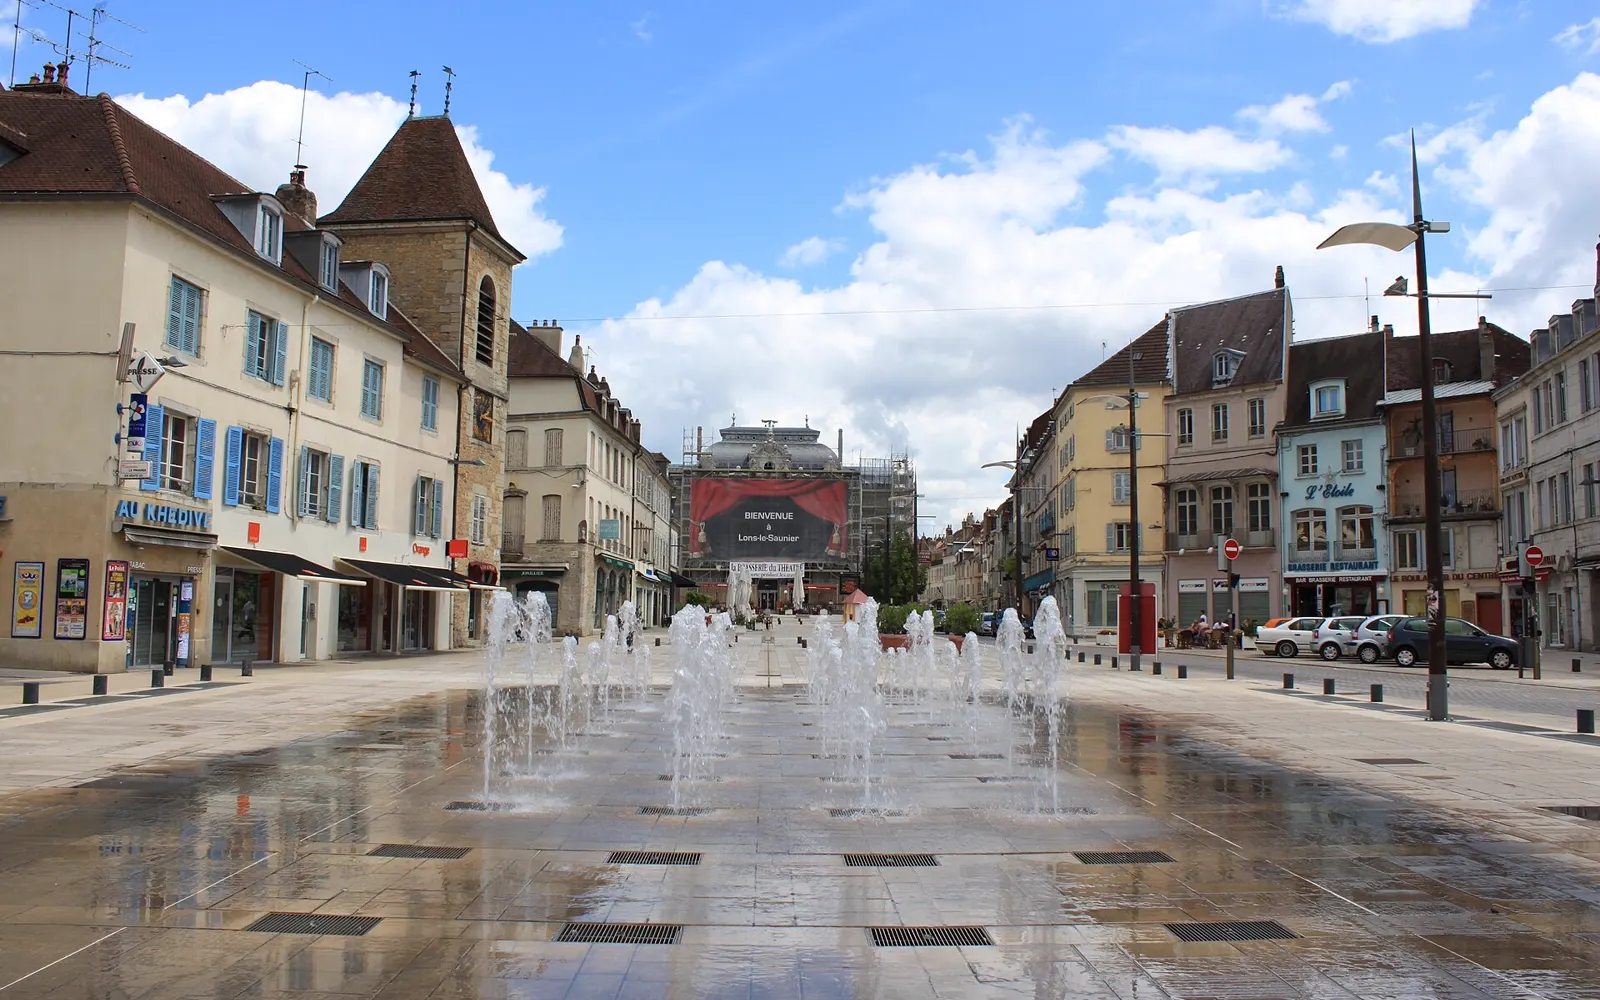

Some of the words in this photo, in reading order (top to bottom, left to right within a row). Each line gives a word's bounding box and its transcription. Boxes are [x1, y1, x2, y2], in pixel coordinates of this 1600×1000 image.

[127, 367, 158, 376] PRESSE
[1305, 482, 1355, 500] L'Etoile
[118, 500, 139, 518] AU
[143, 503, 213, 529] KHEDIVE
[744, 512, 794, 520] BIENVENUE
[766, 523, 772, 531] à
[738, 533, 800, 542] Lons-le-Saunier
[1330, 561, 1379, 570] RESTAURANT
